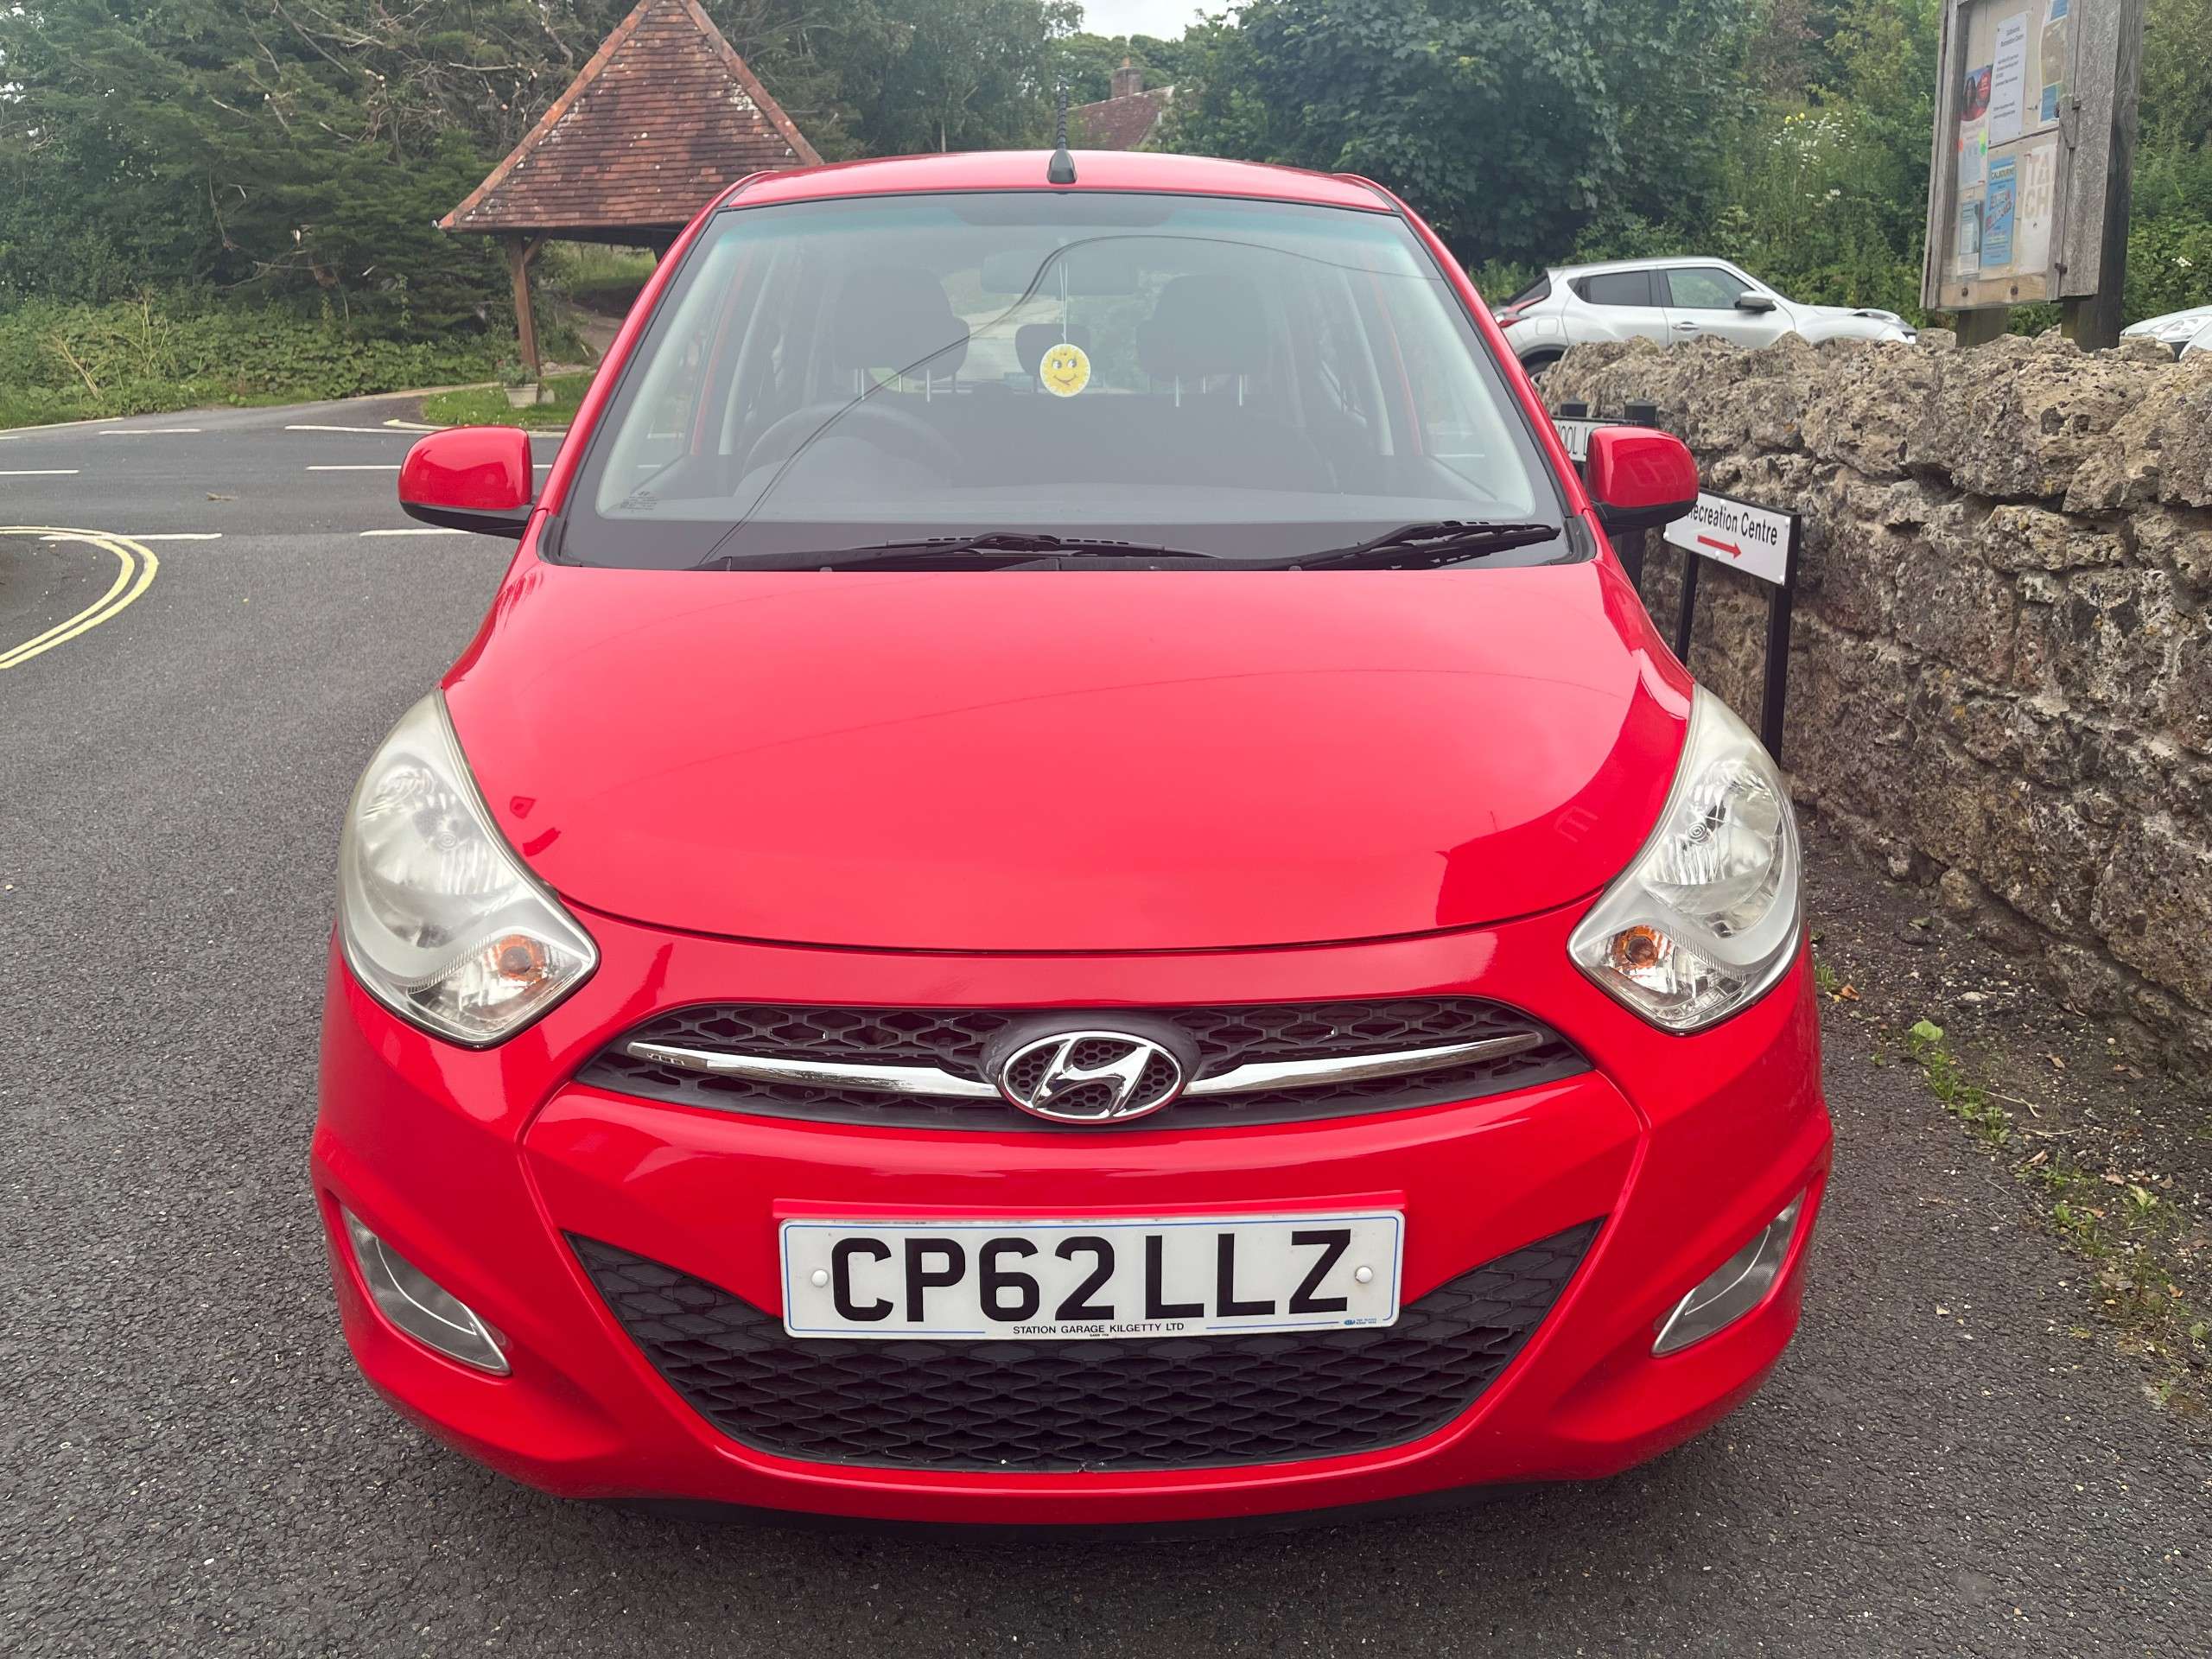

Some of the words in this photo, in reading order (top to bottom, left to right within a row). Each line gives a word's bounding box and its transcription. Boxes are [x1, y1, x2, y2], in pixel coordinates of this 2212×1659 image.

[1558, 424, 1577, 454] OOL
[1687, 504, 1738, 533] ecreation
[1741, 512, 1777, 546] Centre
[831, 1236, 1115, 1322] CP62
[1145, 1229, 1351, 1319] LLZ
[1013, 1325, 1056, 1334] STATION
[1061, 1325, 1105, 1333] GARAGE
[1109, 1323, 1161, 1332] KILGETTY
[1166, 1323, 1185, 1332] LTD
